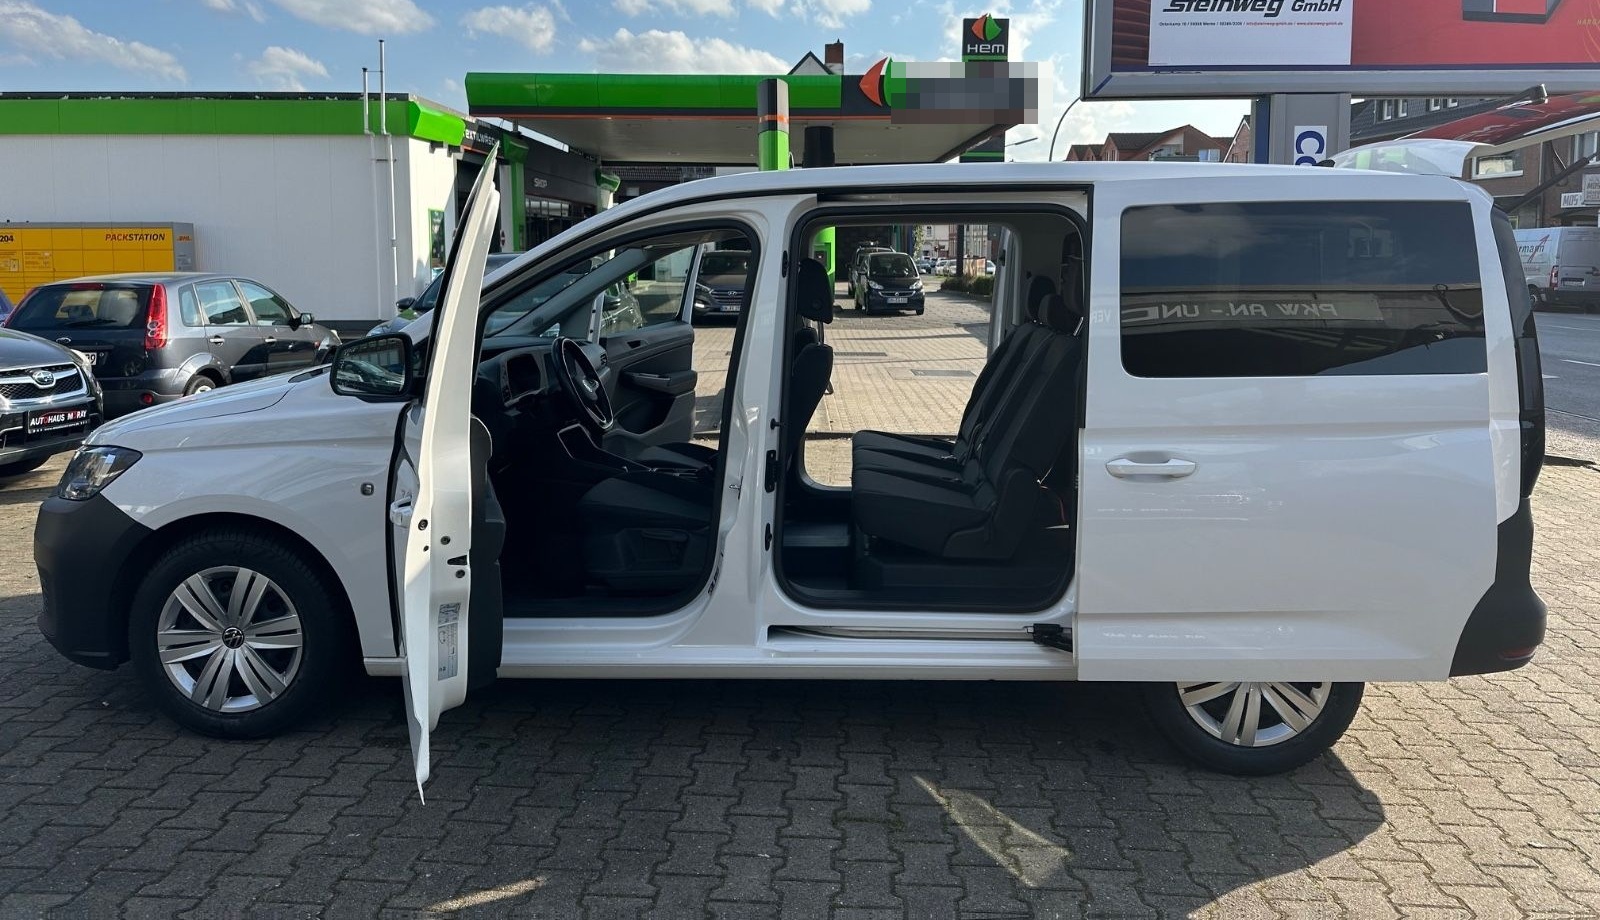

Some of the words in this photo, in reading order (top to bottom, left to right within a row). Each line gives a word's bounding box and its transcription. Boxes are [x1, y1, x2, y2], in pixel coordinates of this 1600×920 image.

[1291, 0, 1343, 12] GmbH
[105, 233, 165, 242] PACKSTATION
[30, 413, 65, 427] AUTOHAUS
